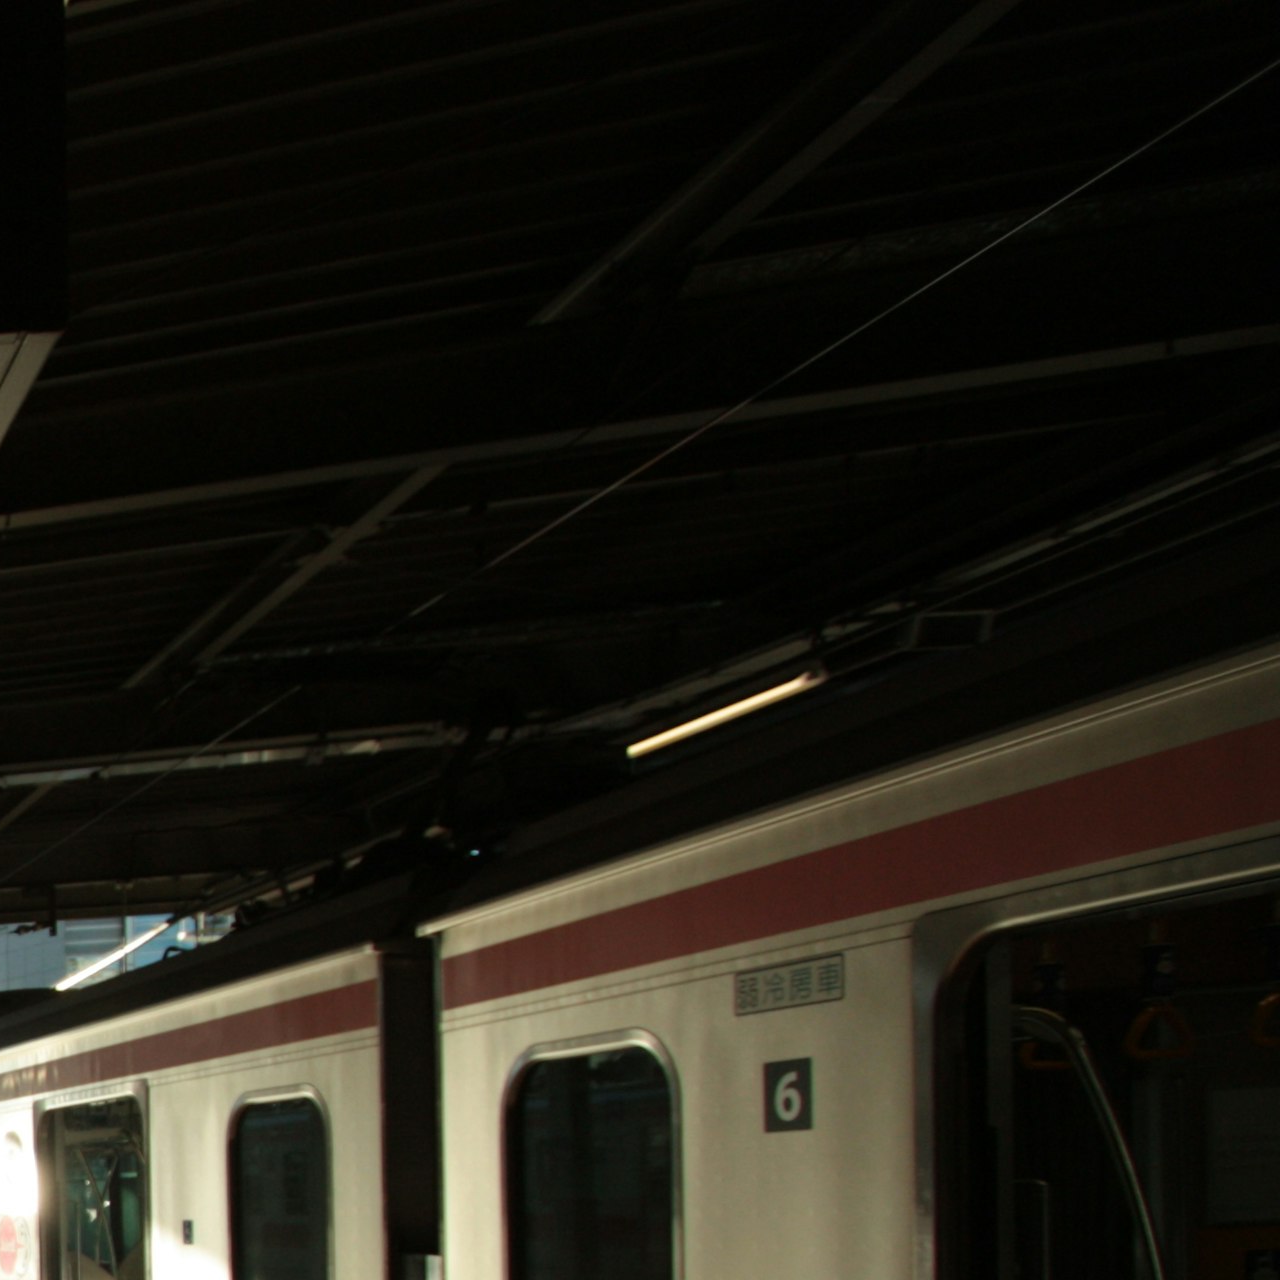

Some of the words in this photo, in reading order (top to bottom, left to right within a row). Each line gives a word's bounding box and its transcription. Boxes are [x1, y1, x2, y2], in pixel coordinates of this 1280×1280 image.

[737, 963, 841, 1009] 弱冷房車
[773, 1070, 802, 1122] 6
